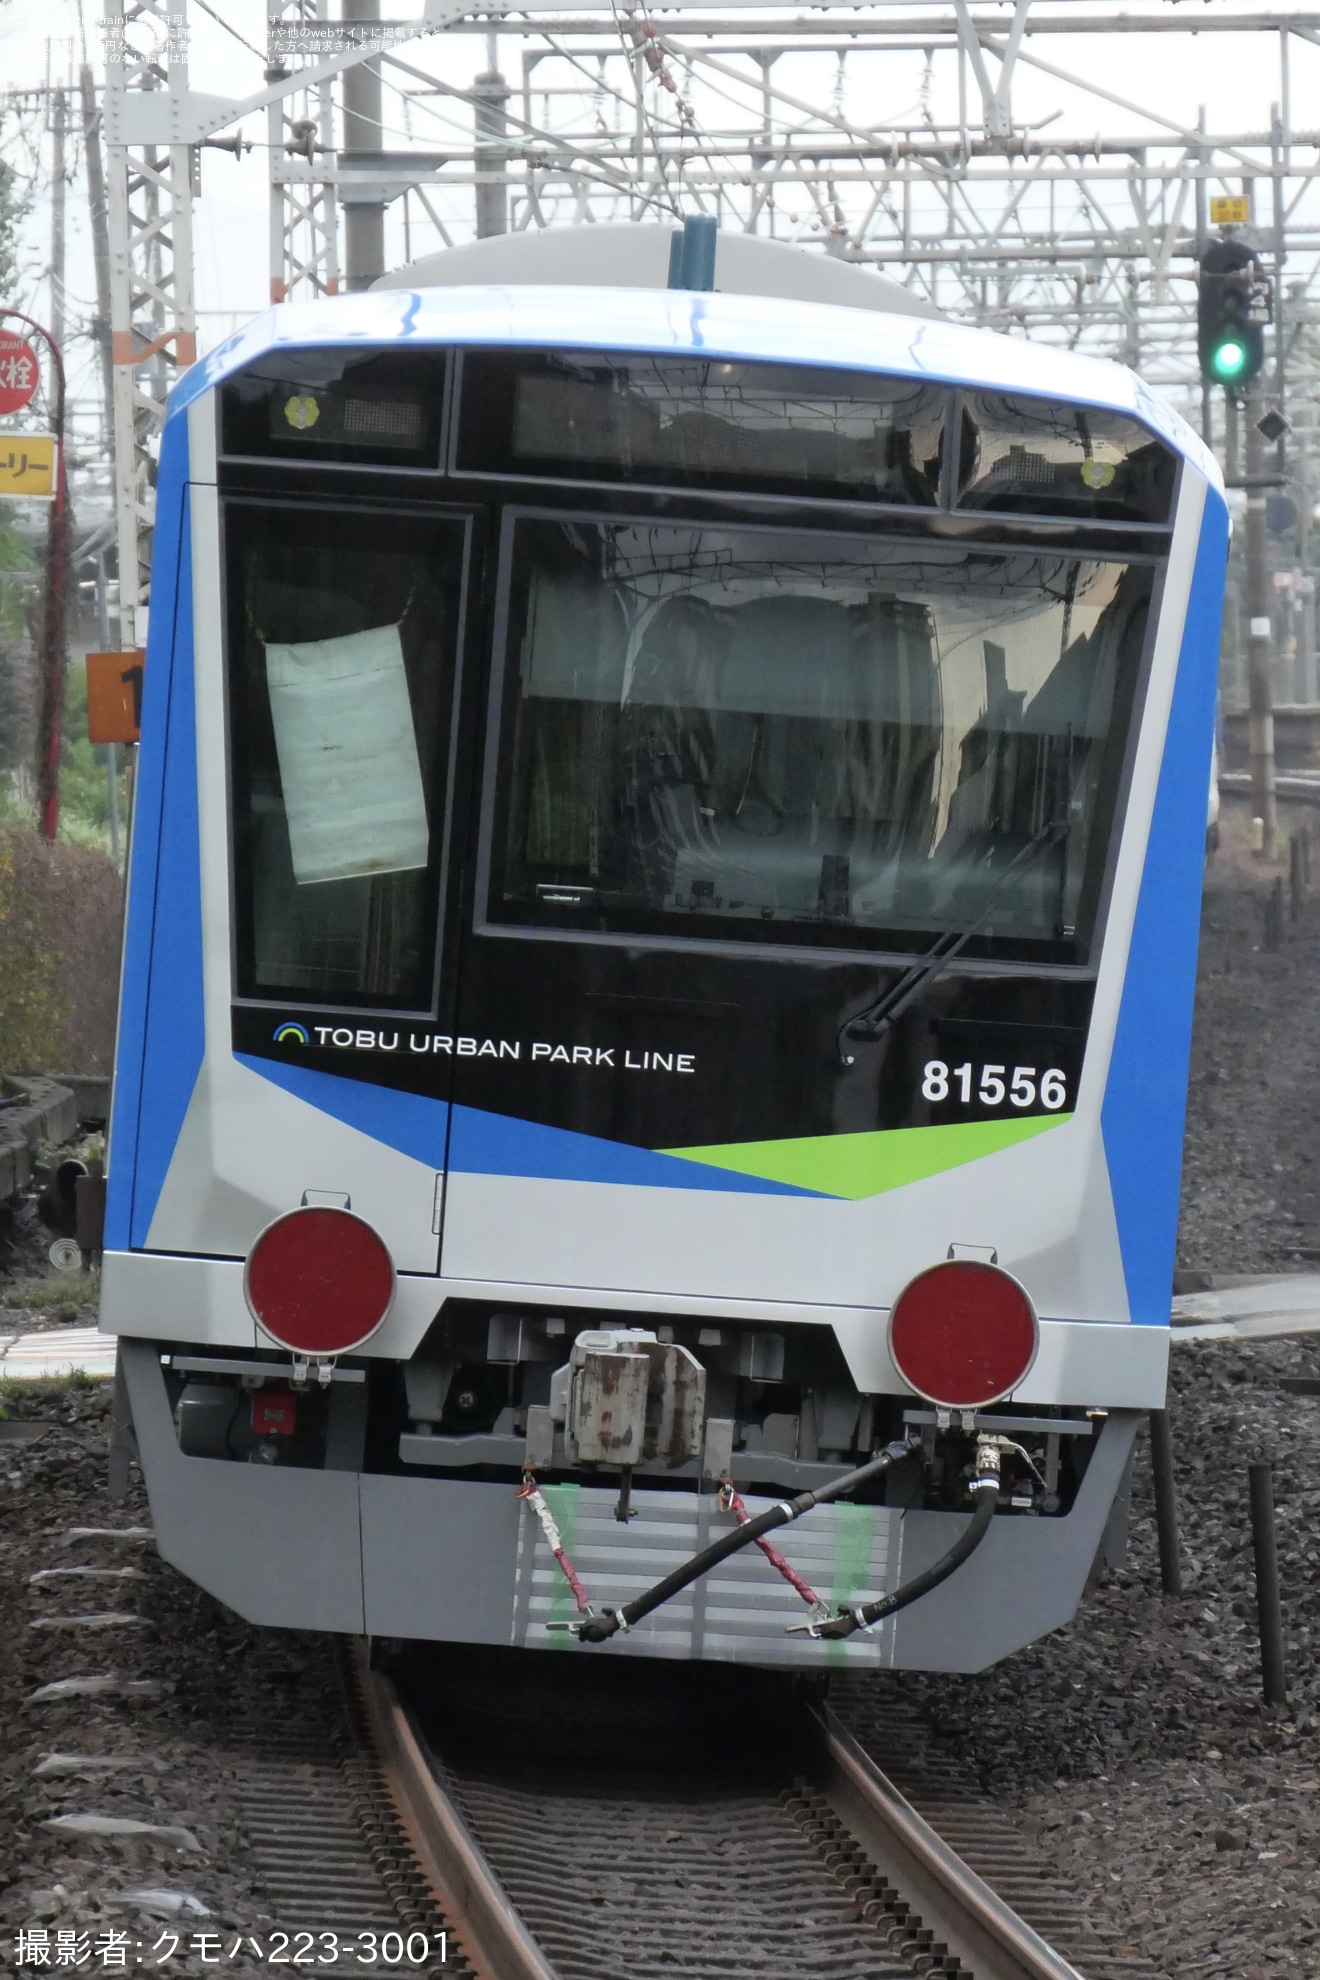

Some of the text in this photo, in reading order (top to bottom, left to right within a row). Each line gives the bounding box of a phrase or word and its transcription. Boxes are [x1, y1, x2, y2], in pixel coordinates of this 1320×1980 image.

[0, 355, 33, 389] 栓
[314, 1027, 696, 1073] TOBU URBAN PARK LINE
[922, 1060, 1066, 1109] 81556
